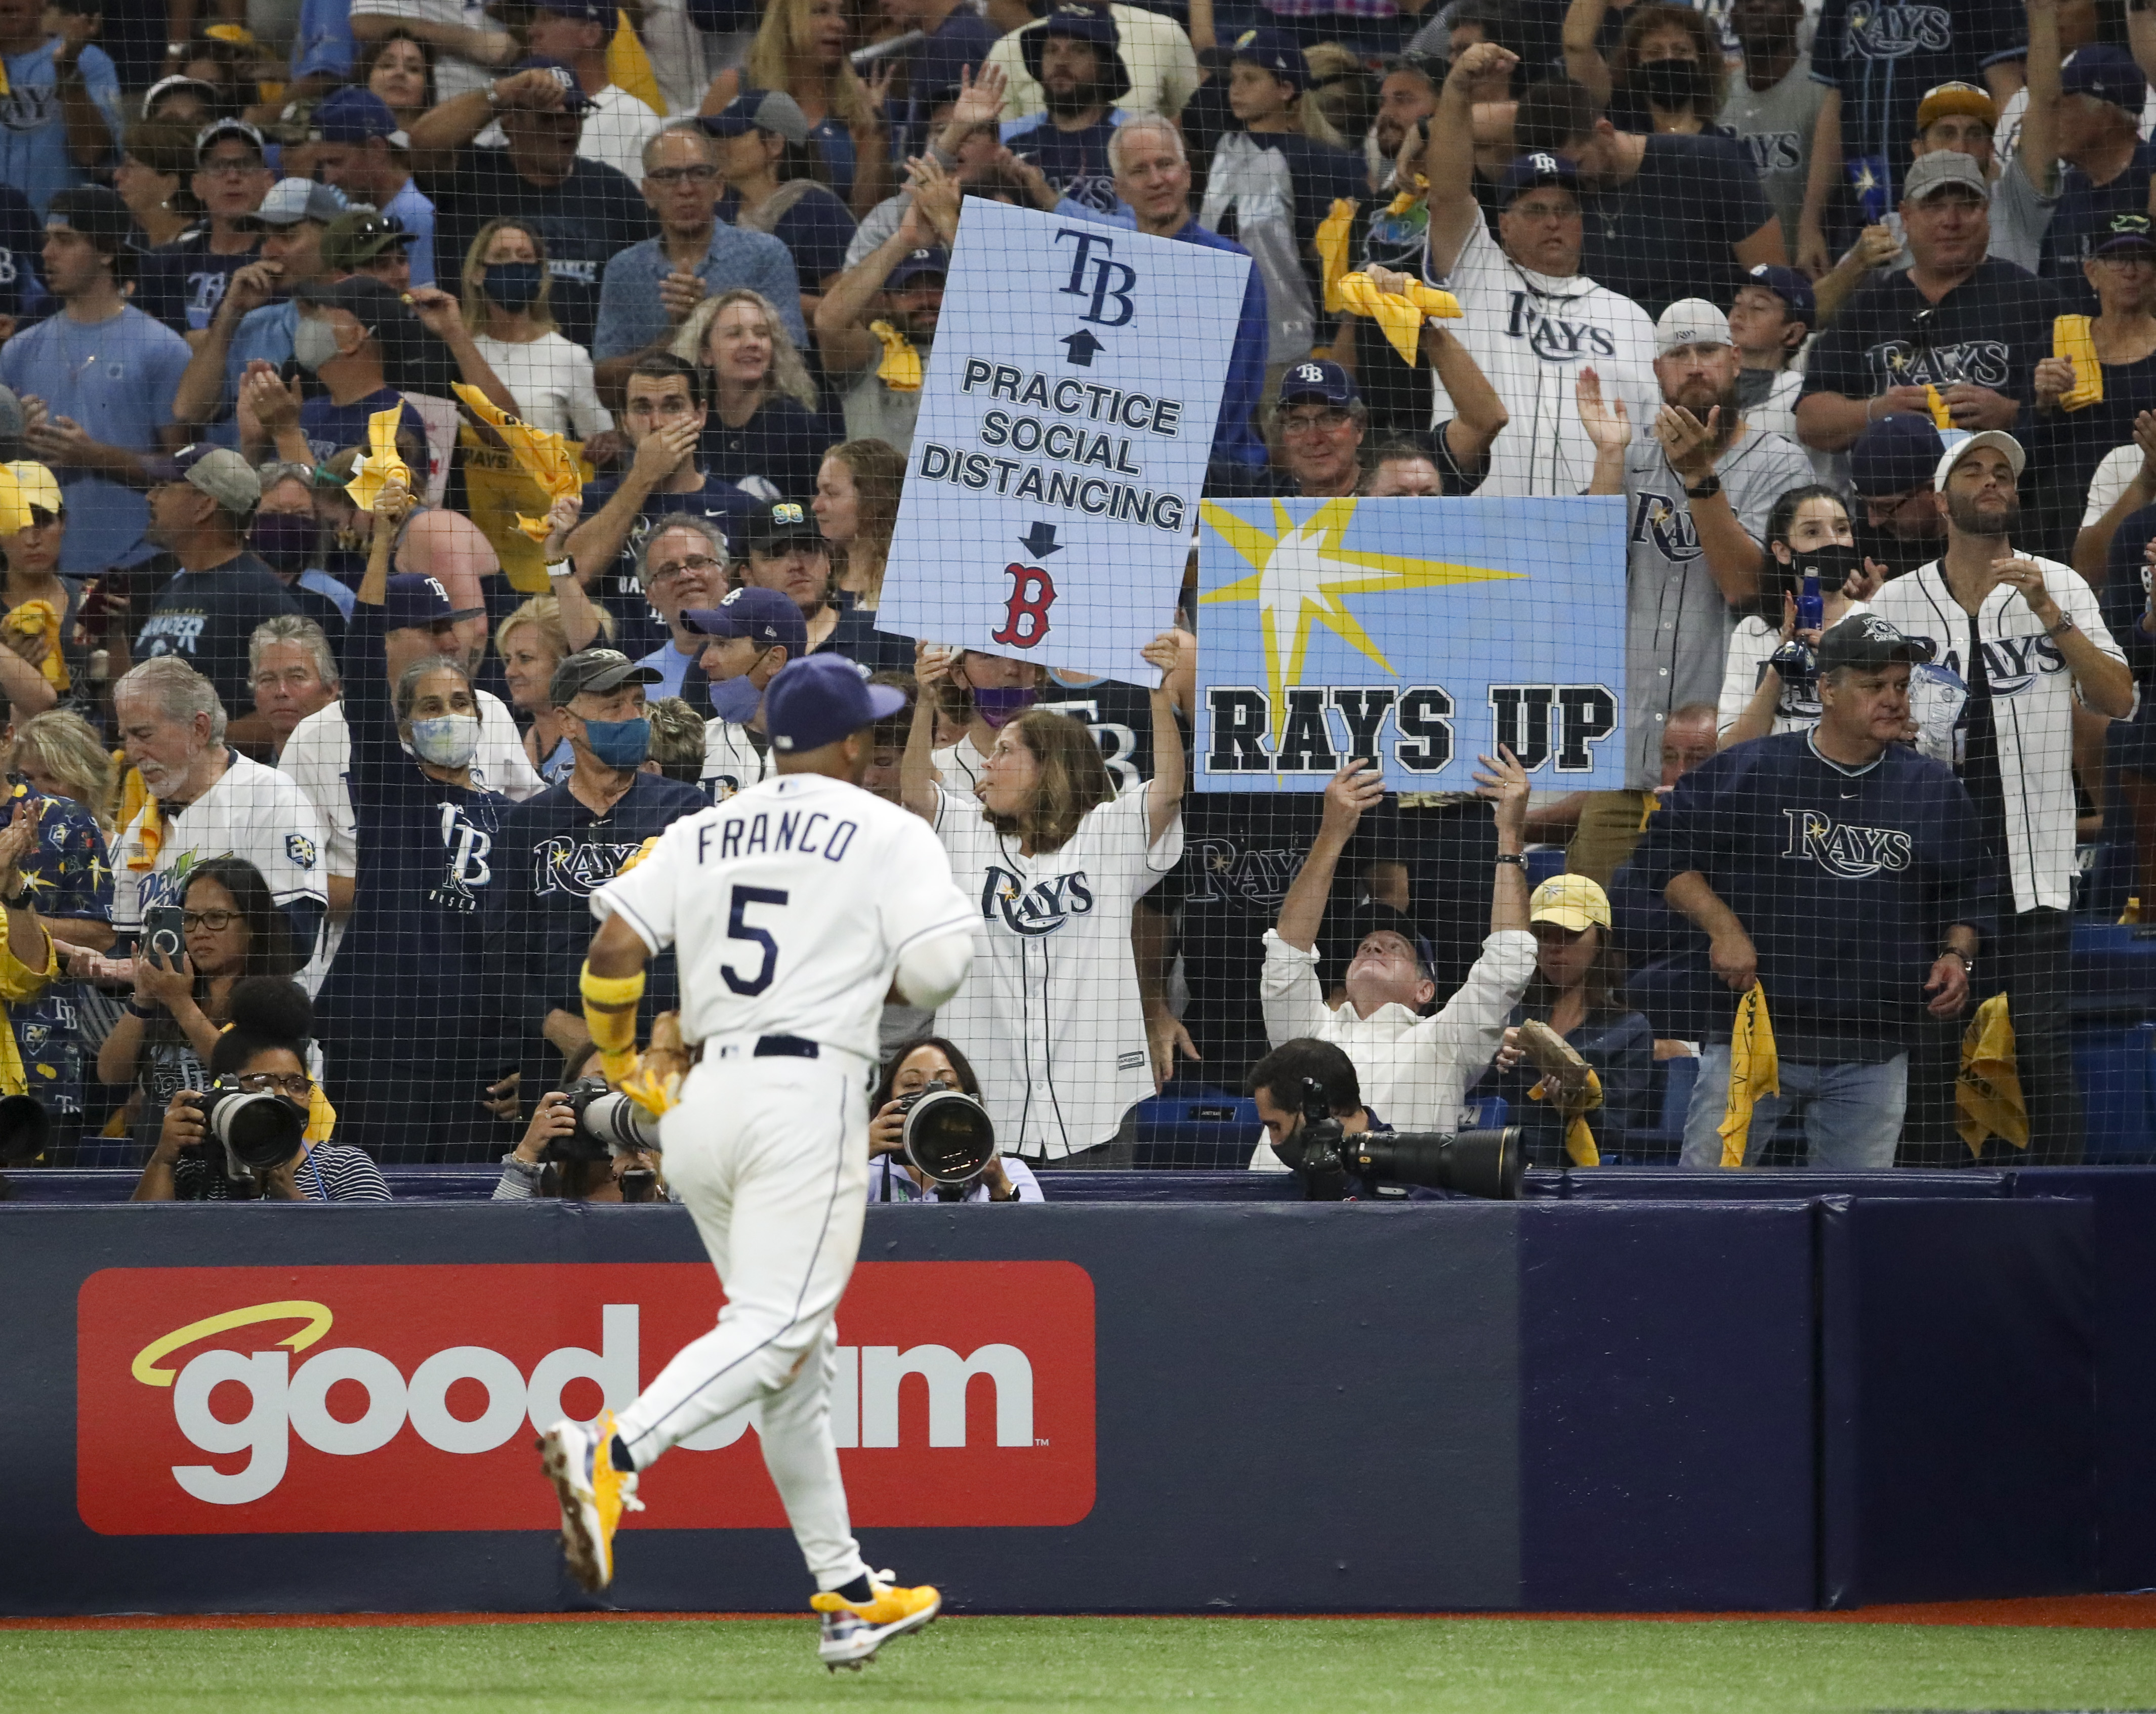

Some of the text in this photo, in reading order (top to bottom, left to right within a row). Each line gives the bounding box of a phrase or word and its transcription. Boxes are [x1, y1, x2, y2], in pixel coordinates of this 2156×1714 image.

[1842, 2, 1950, 60] RAYS
[1054, 228, 1135, 326] TB
[1503, 290, 1614, 362] RAYS
[961, 357, 1183, 438] PRACTICE
[1296, 363, 1323, 383] TB
[980, 409, 1142, 477] SOCIAL
[918, 442, 1185, 533] DISTANCING
[991, 562, 1058, 650] B
[1205, 683, 1619, 775] RAYS UP
[698, 811, 857, 864] FRANCO
[1781, 809, 1912, 879] RAYS
[981, 866, 1094, 937] RAYS
[720, 885, 788, 996] 5
